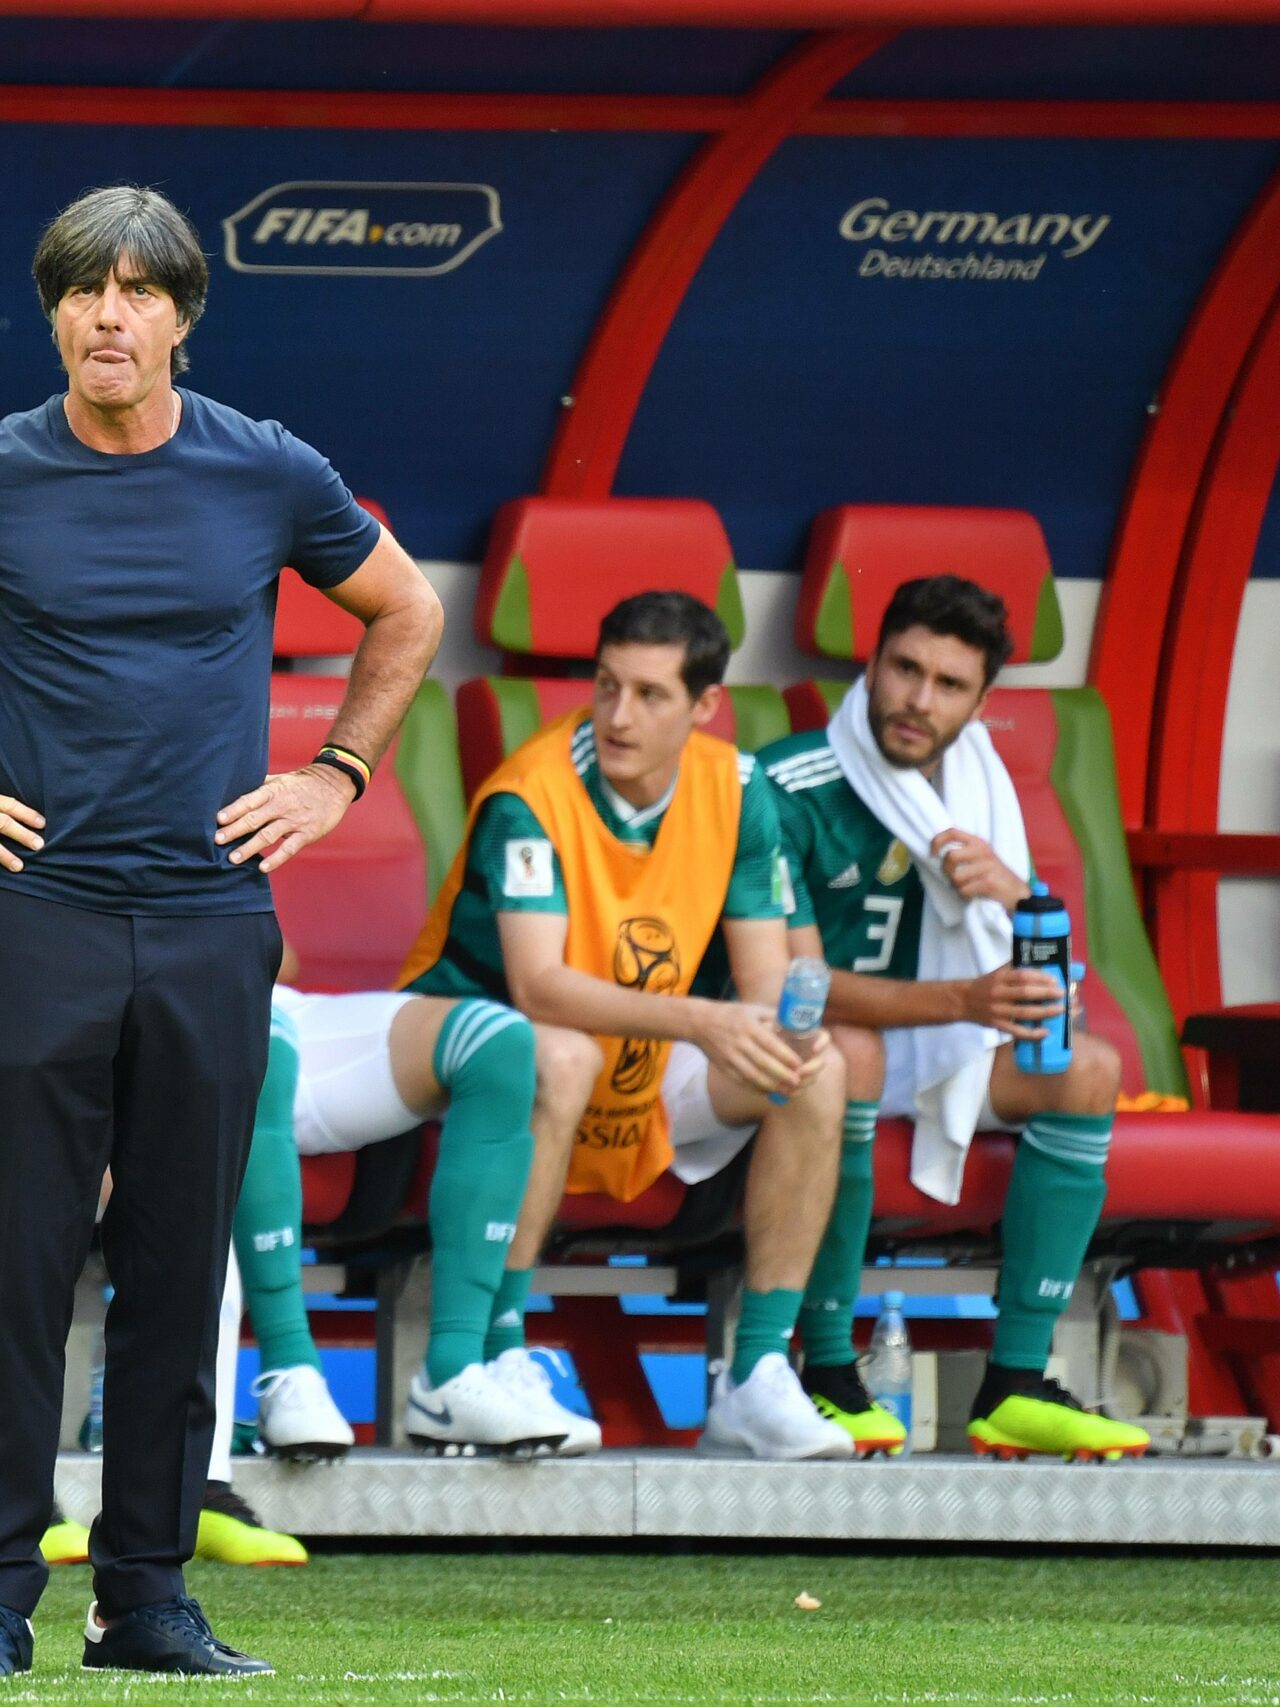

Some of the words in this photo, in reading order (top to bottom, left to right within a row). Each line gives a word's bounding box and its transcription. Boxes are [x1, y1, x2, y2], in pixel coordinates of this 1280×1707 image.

[838, 197, 1111, 258] Germany
[858, 249, 1048, 280] Deutschland
[852, 893, 904, 972] 3
